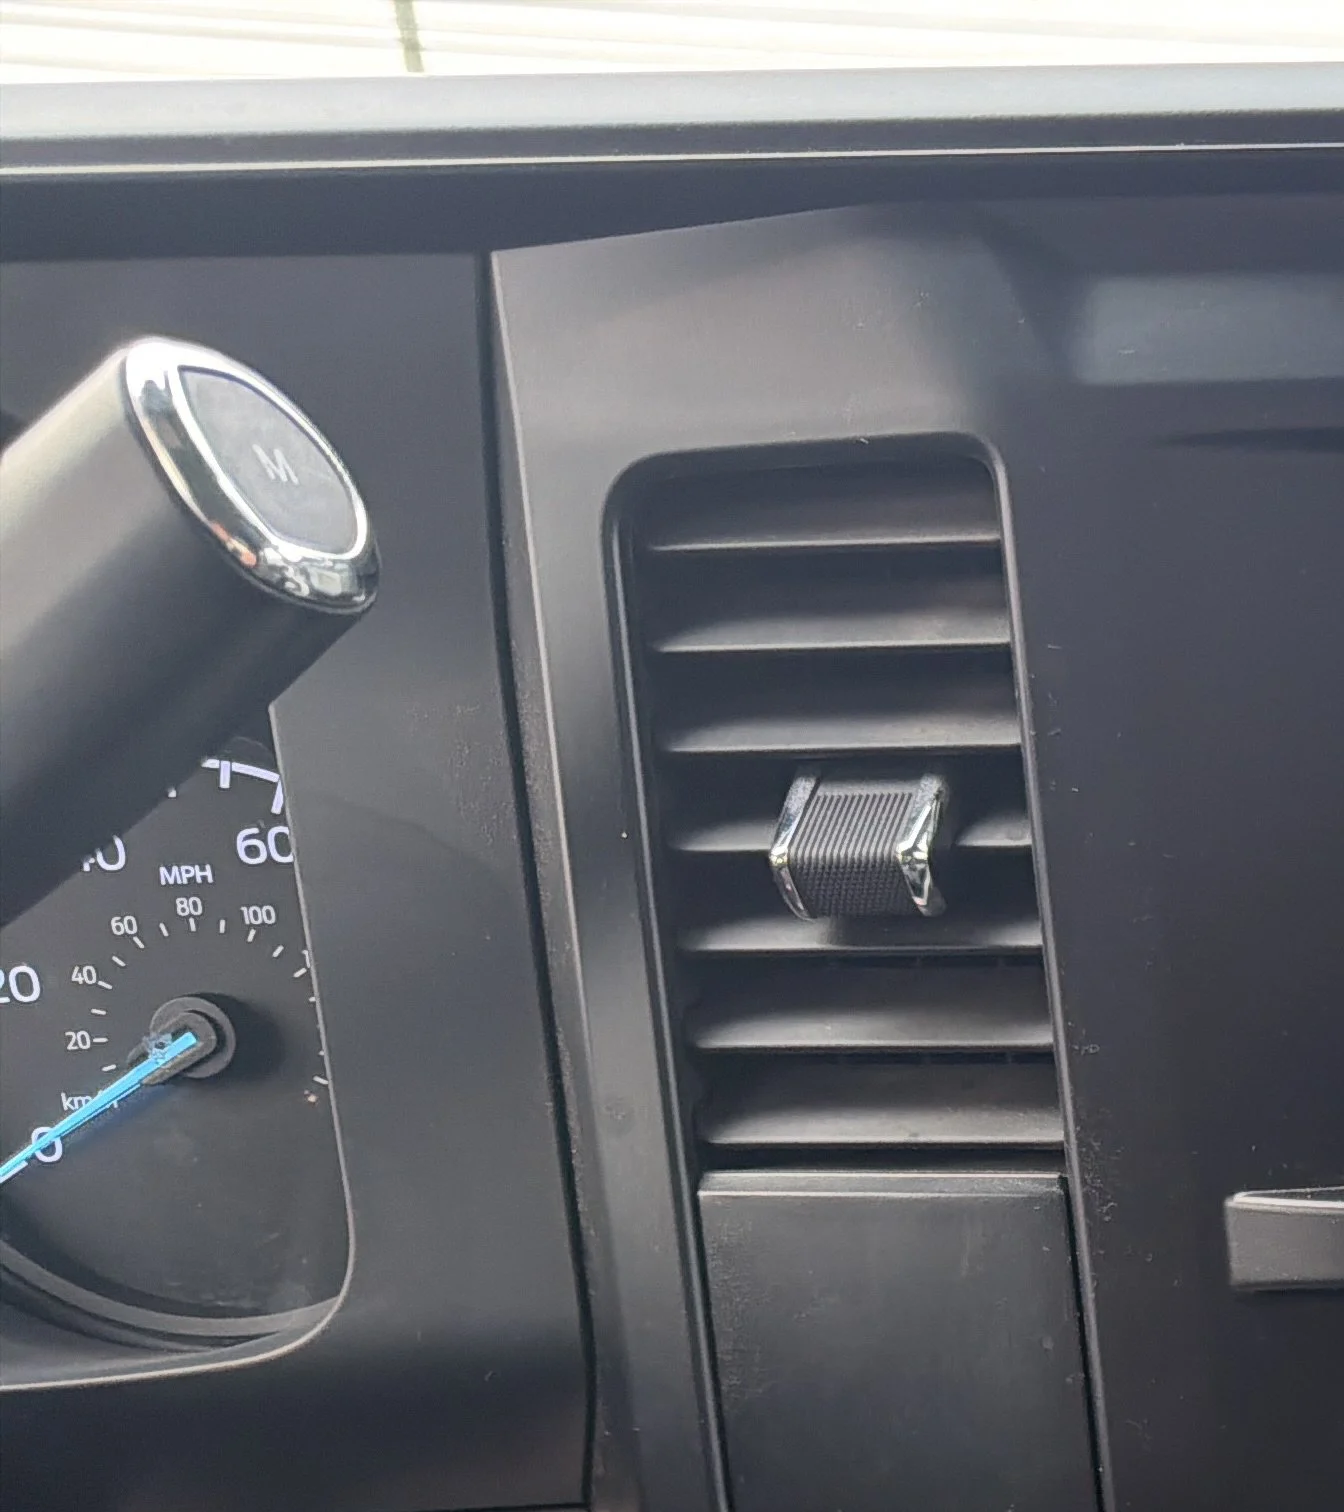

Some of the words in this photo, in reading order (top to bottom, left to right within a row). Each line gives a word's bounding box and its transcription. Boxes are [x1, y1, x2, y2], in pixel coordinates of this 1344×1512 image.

[252, 443, 299, 485] M
[236, 826, 294, 865] 60
[159, 864, 214, 886] MPH
[176, 896, 203, 917] 80
[240, 905, 276, 926] 100
[111, 915, 138, 937] 60
[71, 965, 97, 985] 40
[64, 1030, 91, 1051] 20
